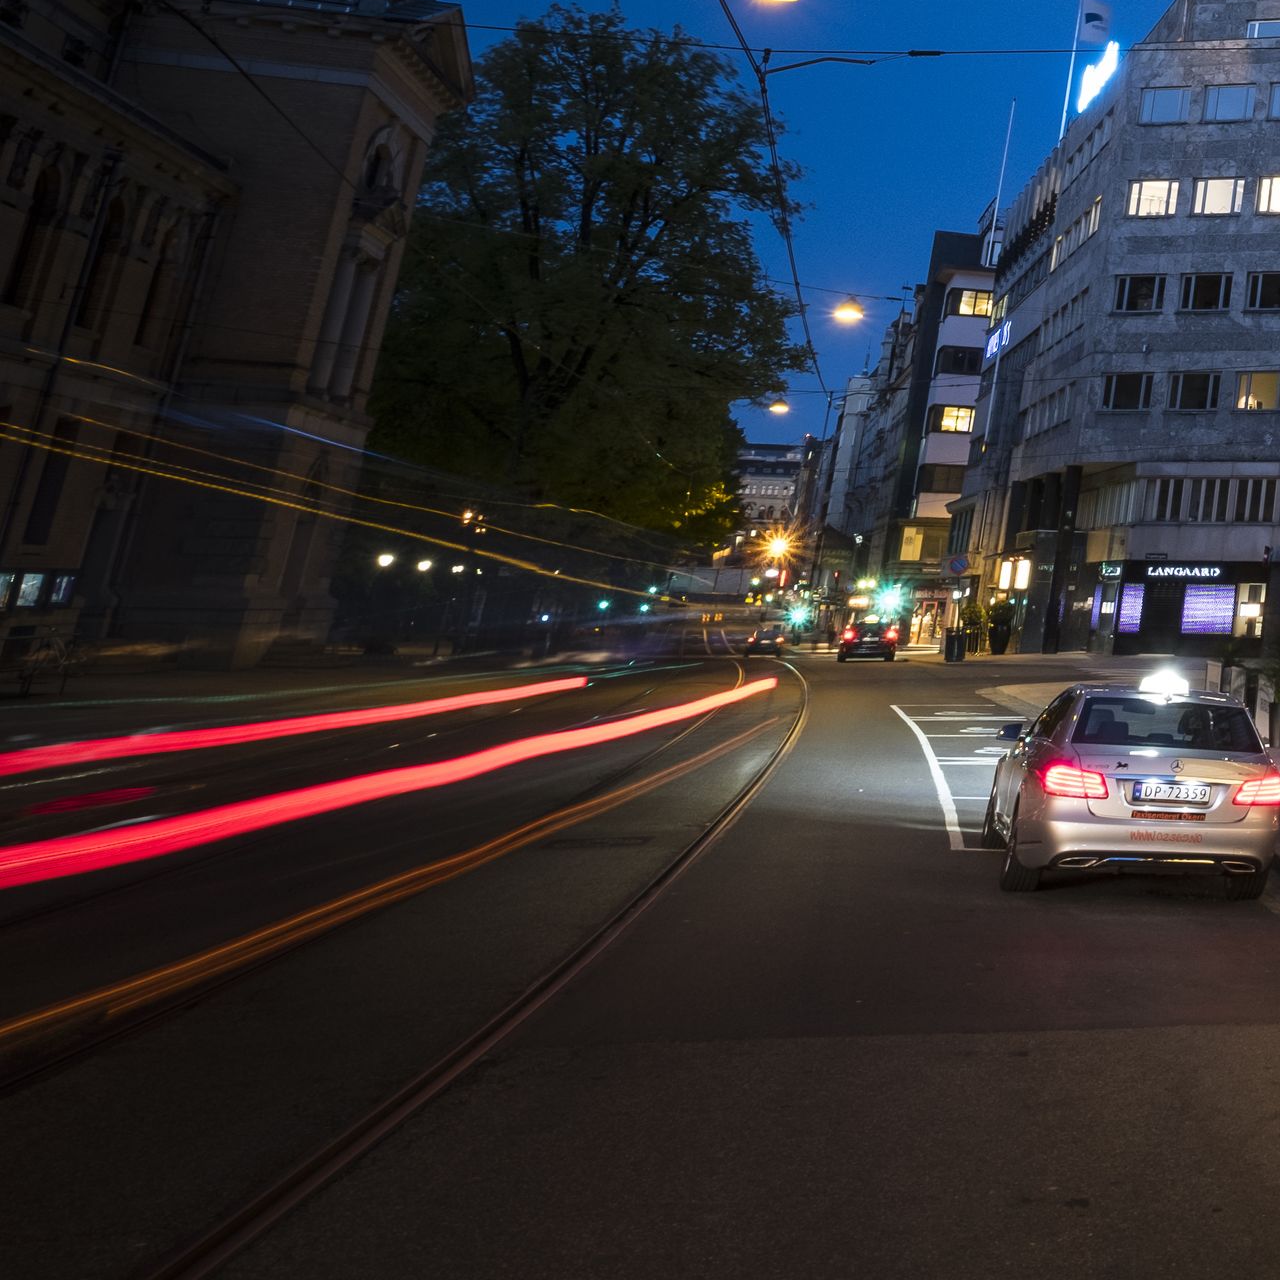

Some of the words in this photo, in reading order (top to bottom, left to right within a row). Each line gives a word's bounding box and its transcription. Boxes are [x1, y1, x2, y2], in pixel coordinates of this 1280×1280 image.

[1147, 566, 1221, 577] LANGAARD
[1144, 785, 1161, 798] DP
[1166, 786, 1207, 800] 72359
